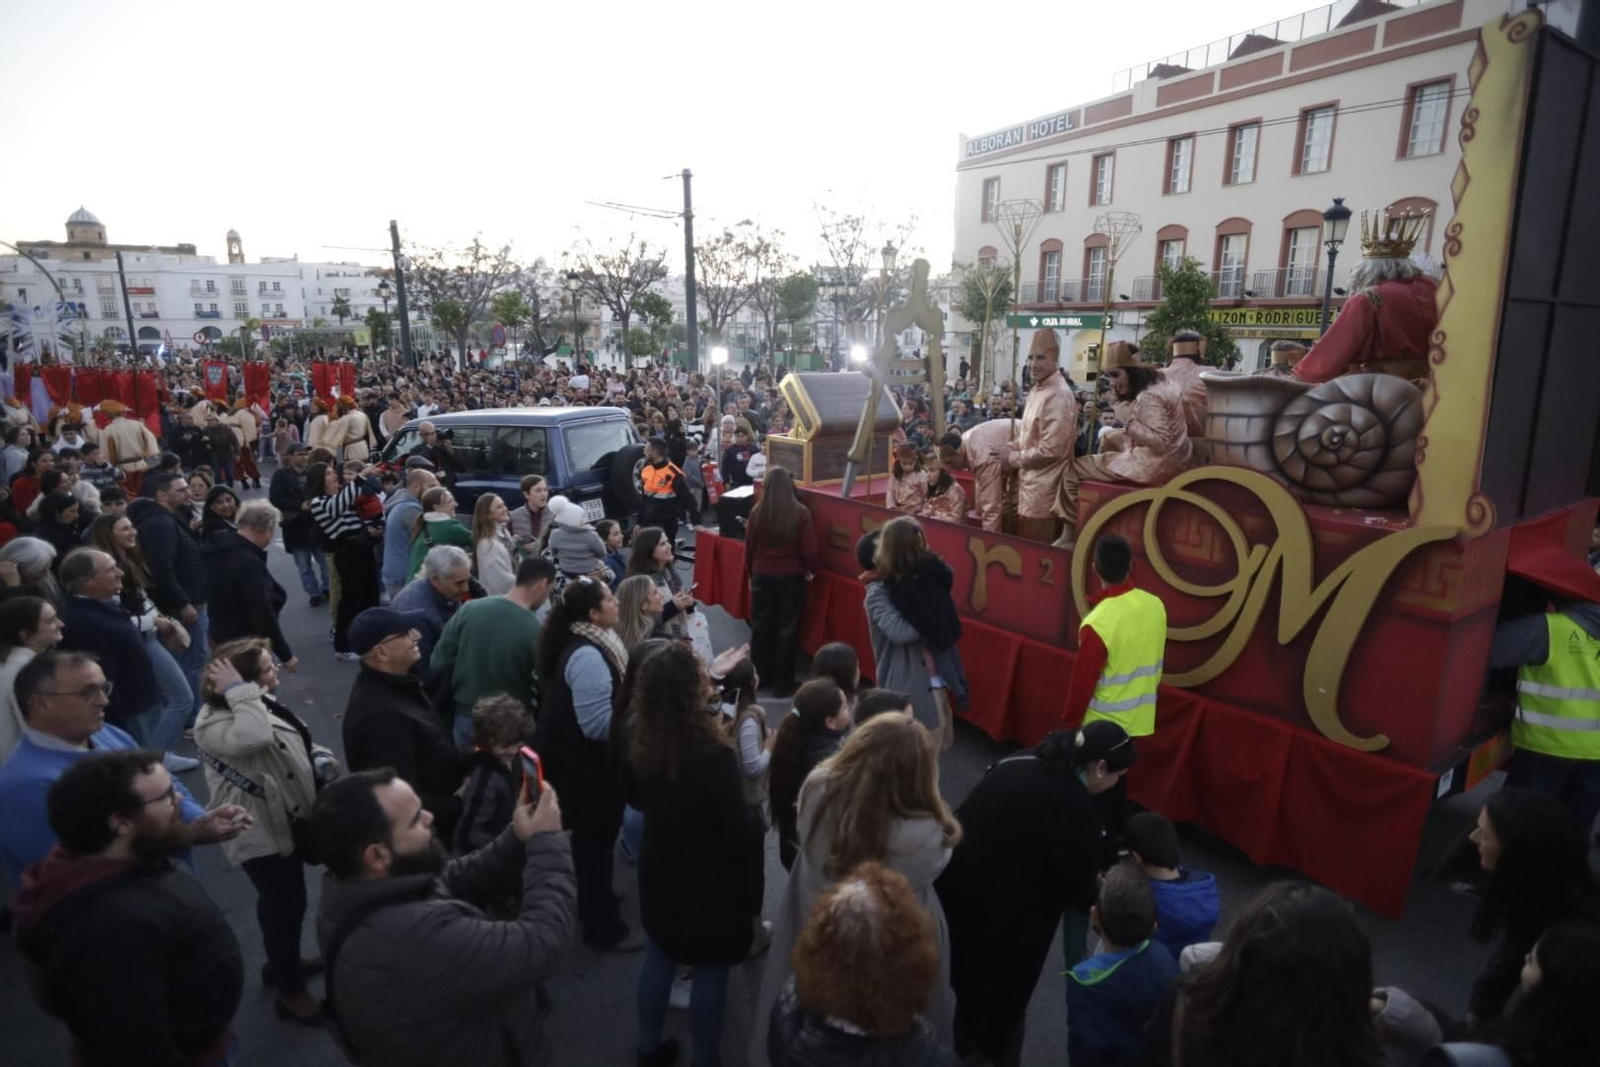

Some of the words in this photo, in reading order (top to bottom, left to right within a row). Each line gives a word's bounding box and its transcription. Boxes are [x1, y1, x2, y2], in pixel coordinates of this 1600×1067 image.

[968, 129, 1021, 156] ALBORAN
[1030, 114, 1073, 138] HOTEL
[1042, 317, 1058, 326] CAJA
[1060, 317, 1082, 326] RURAL
